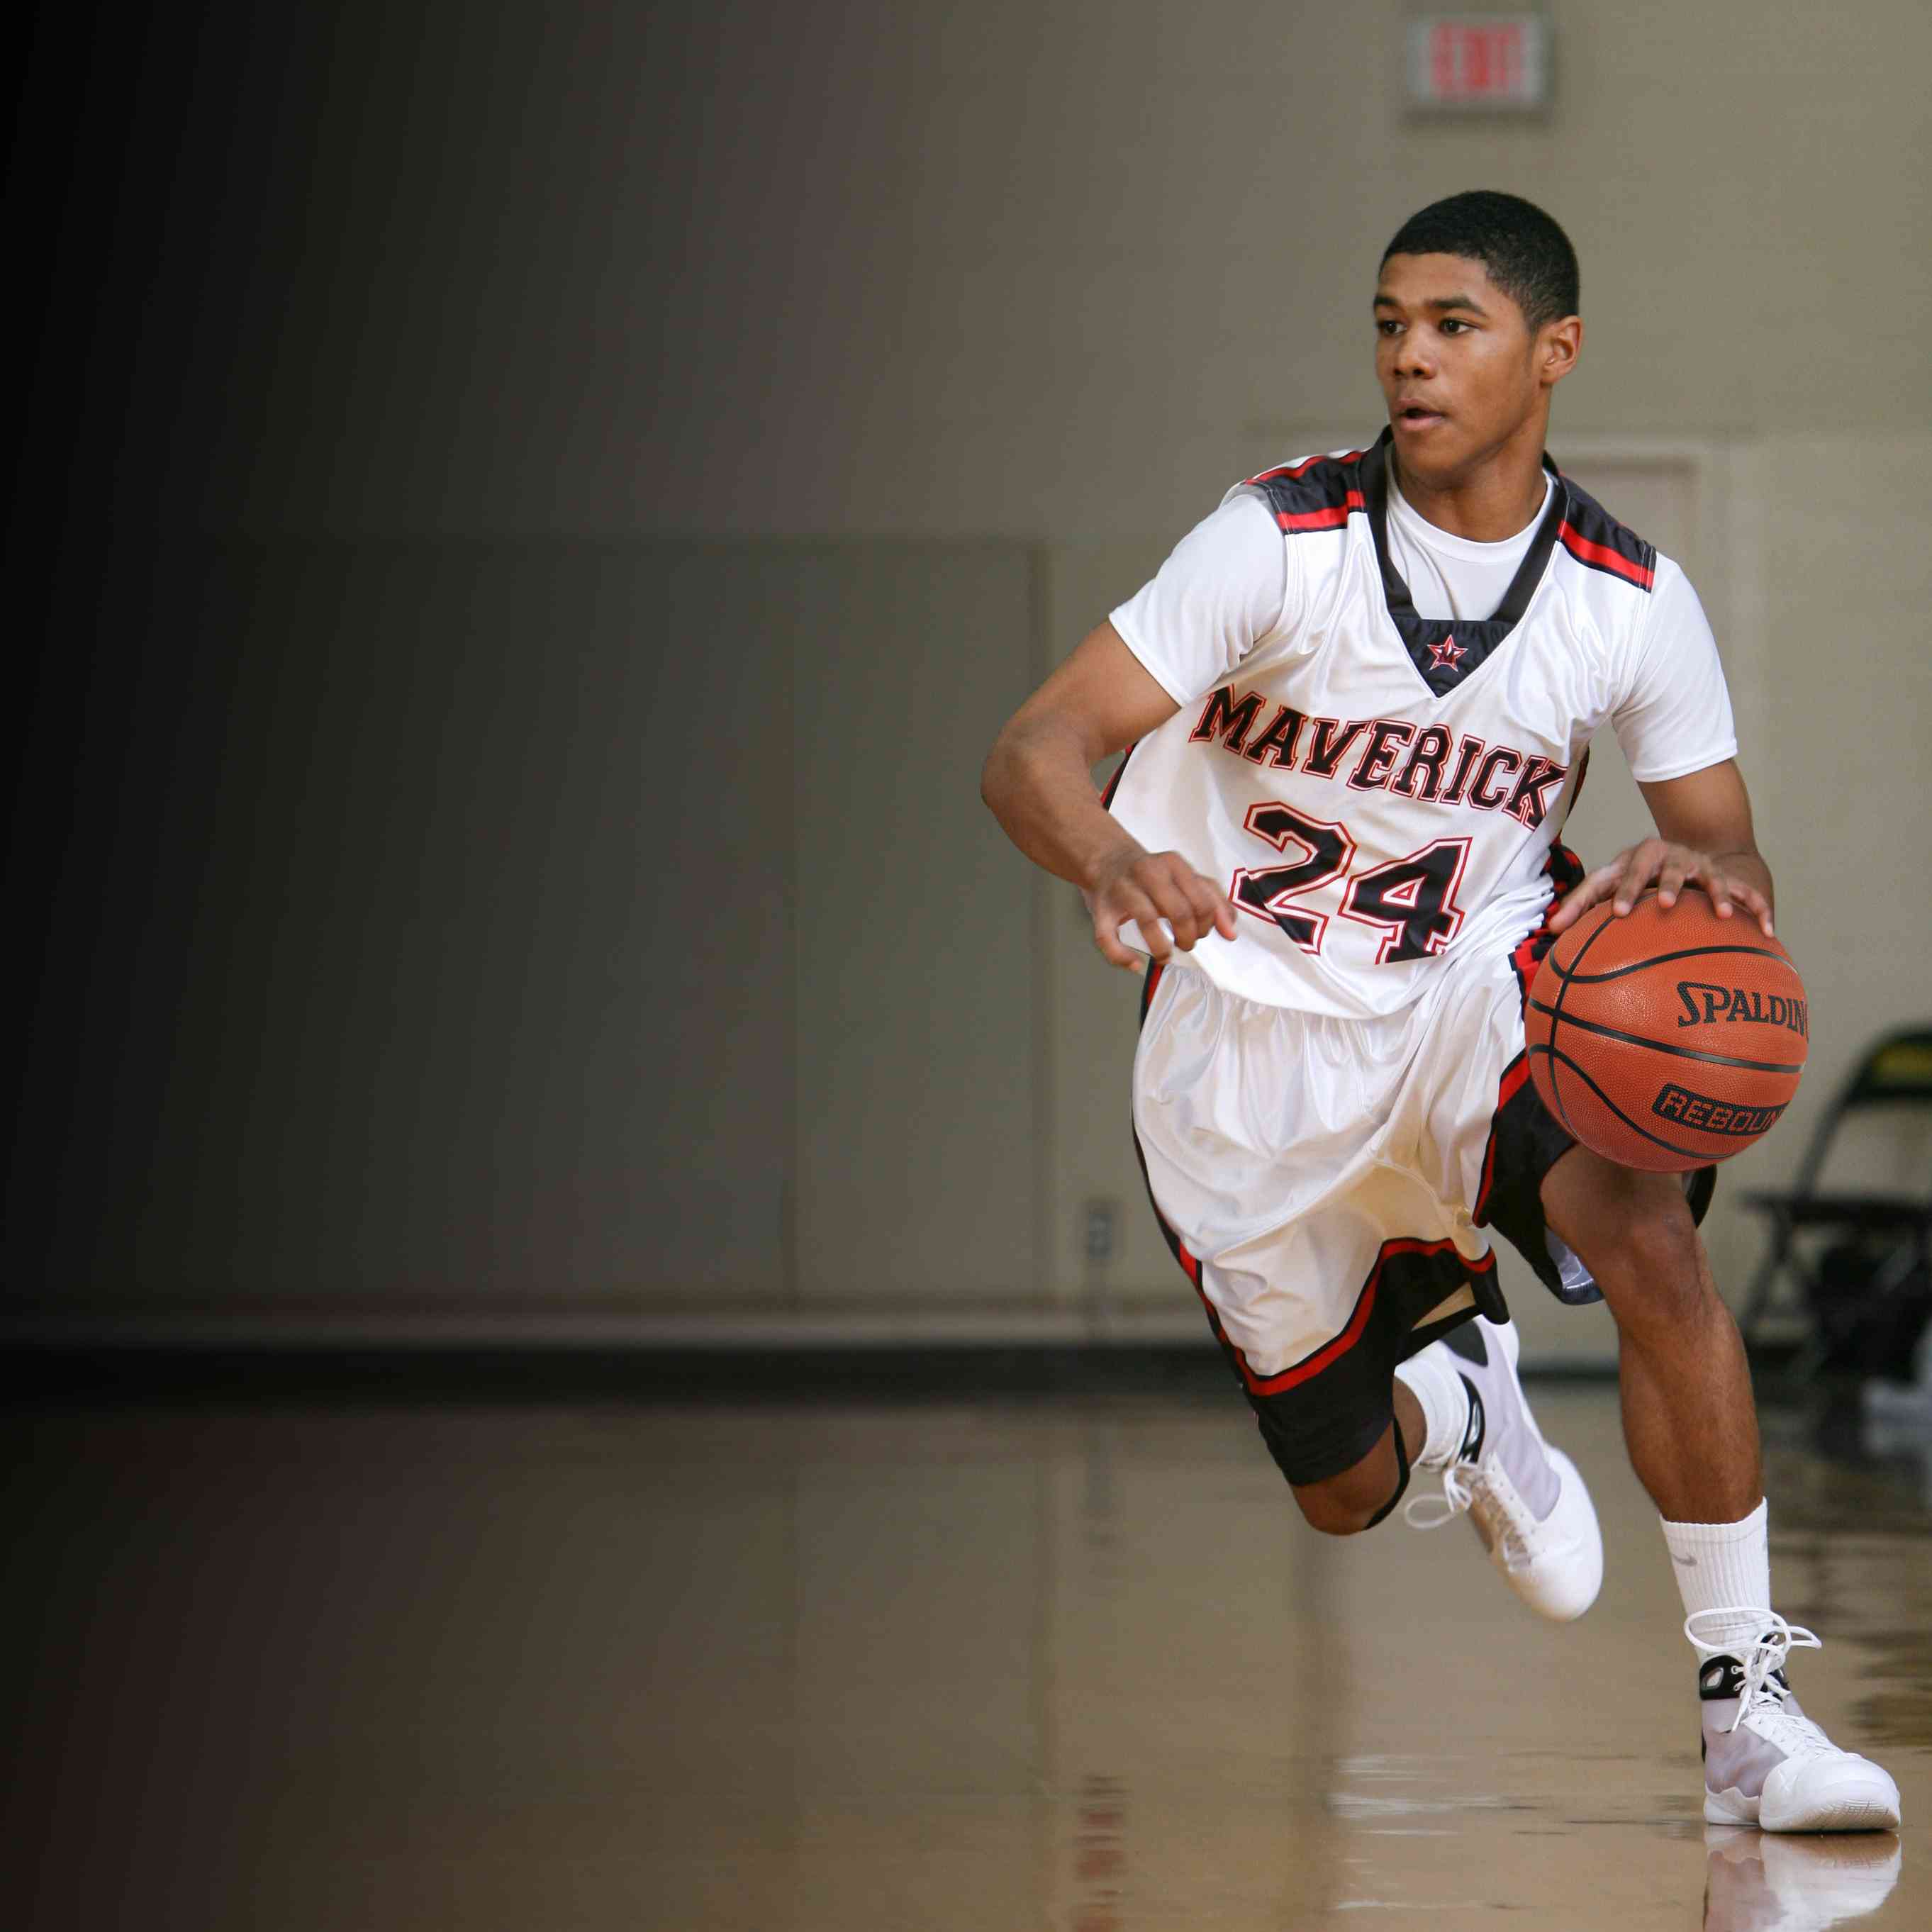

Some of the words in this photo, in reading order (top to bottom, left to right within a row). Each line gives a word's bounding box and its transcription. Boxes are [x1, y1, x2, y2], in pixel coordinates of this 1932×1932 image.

[1188, 684, 1568, 831] MAVERICK
[1228, 801, 1473, 965] 24
[1677, 981, 1809, 1044] SPALDIN
[1660, 1090, 1785, 1132] REBOUN
